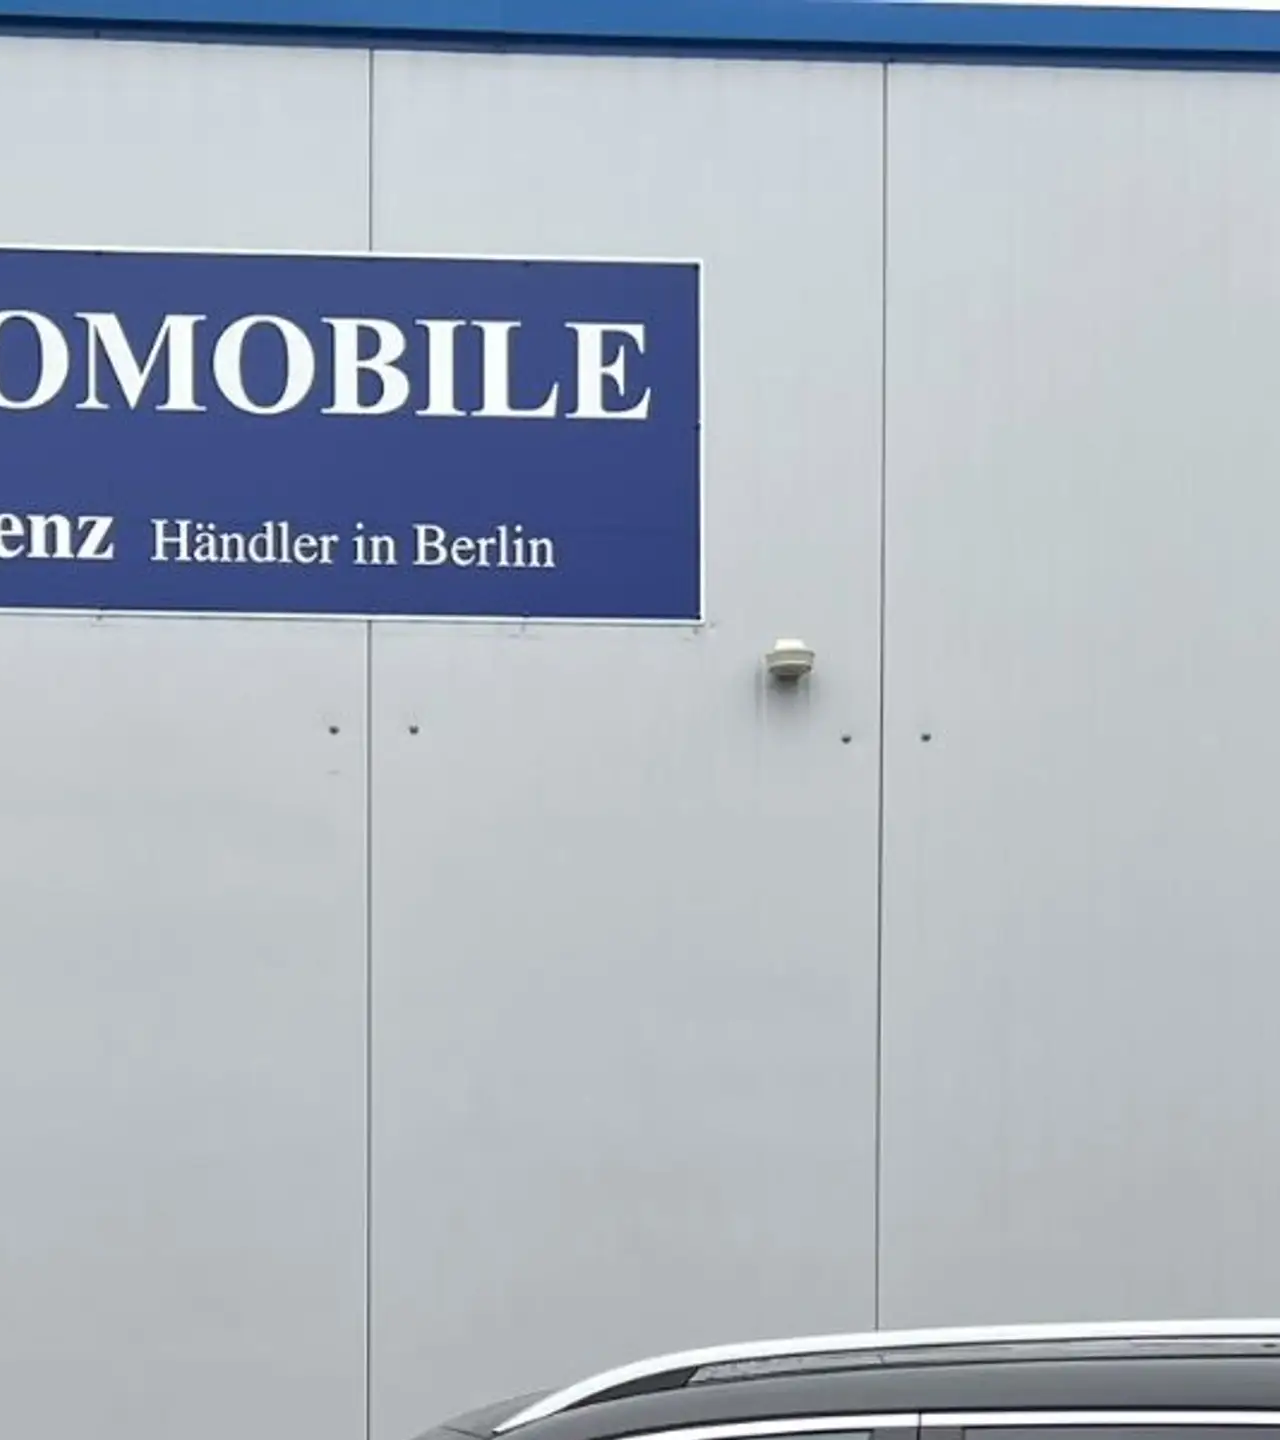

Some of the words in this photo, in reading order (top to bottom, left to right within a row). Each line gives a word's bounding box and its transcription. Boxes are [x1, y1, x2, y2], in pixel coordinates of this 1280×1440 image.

[150, 518, 339, 564] Händler
[353, 522, 397, 565] in
[413, 524, 556, 568] Berlin
